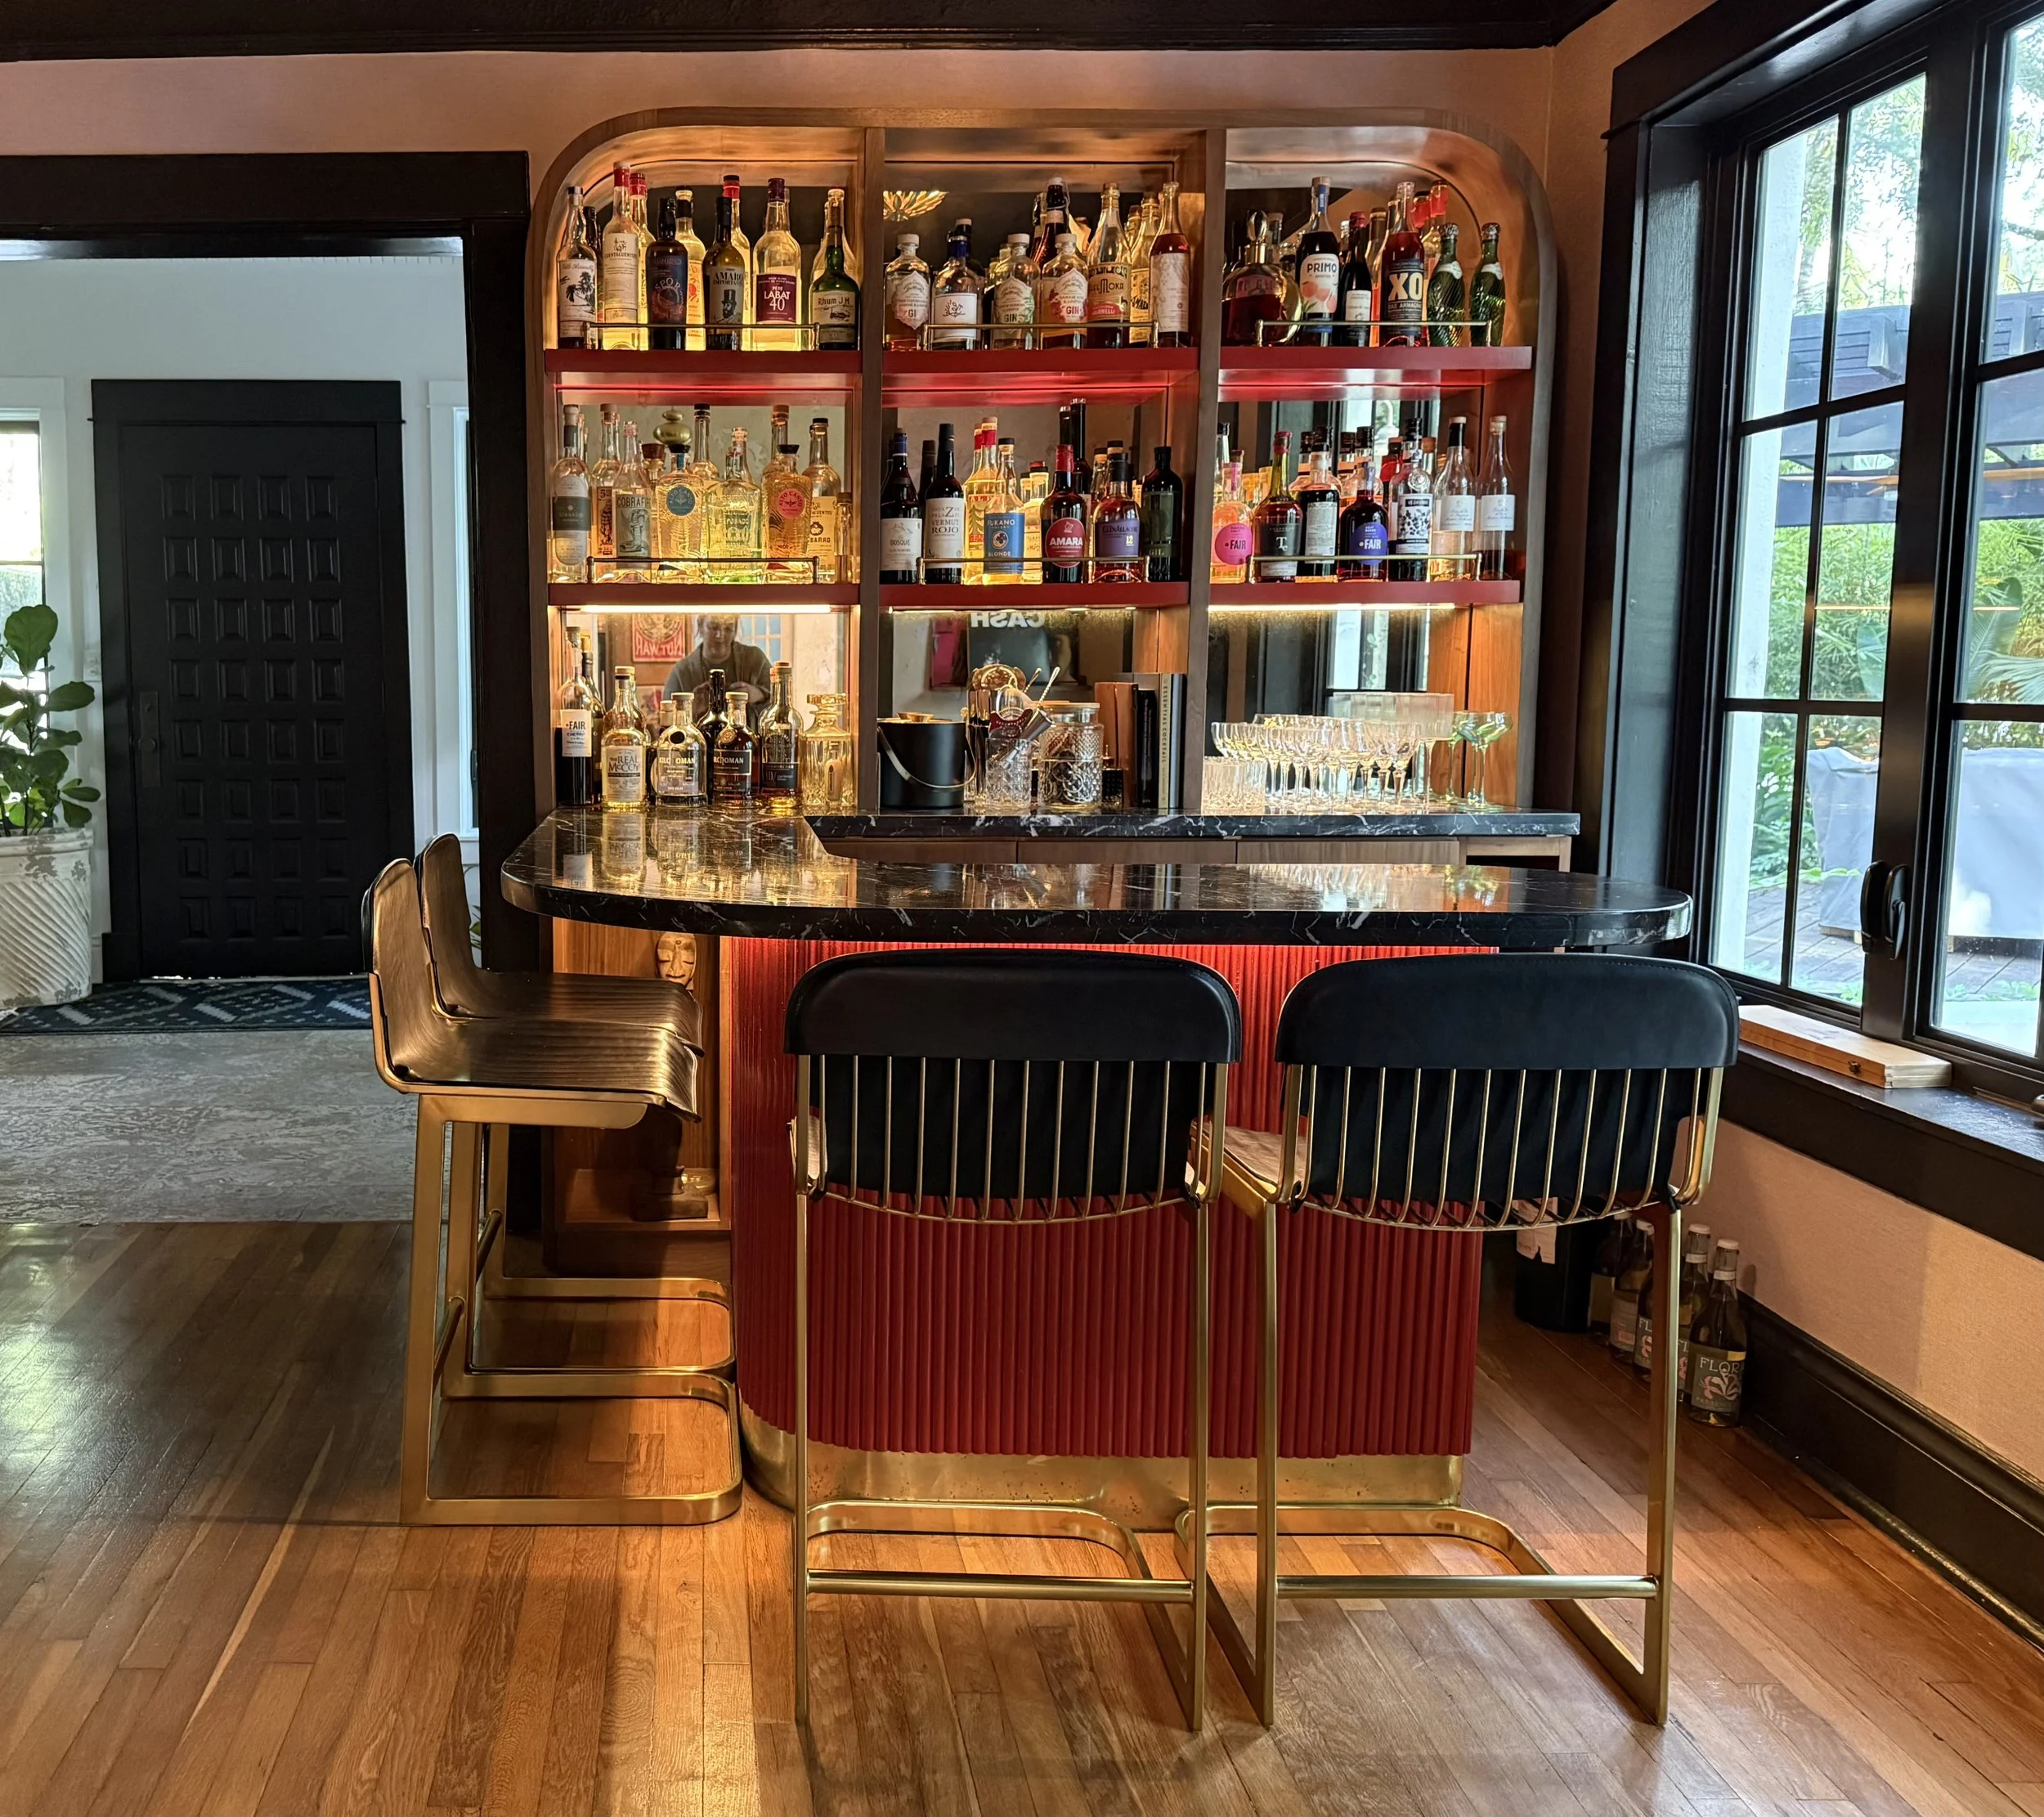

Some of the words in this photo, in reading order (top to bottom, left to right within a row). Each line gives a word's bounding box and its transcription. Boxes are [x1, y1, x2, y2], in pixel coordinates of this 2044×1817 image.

[1307, 262, 1338, 273] PRIMO
[715, 271, 743, 281] AMARO
[1388, 271, 1423, 302] XO
[764, 290, 791, 300] LABAT
[769, 298, 785, 311] 40
[818, 297, 836, 306] Rhum
[1065, 306, 1081, 315] GIN
[1004, 314, 1018, 322] GIN
[931, 526, 959, 534] ROJO
[1049, 536, 1083, 546] AMARA
[1126, 535, 1135, 544] 12
[1364, 539, 1382, 550] FAIR
[1230, 540, 1247, 550] FAIR
[569, 720, 586, 730] FAIR
[617, 755, 639, 764] REAL
[1699, 1356, 1741, 1375] FLOR
